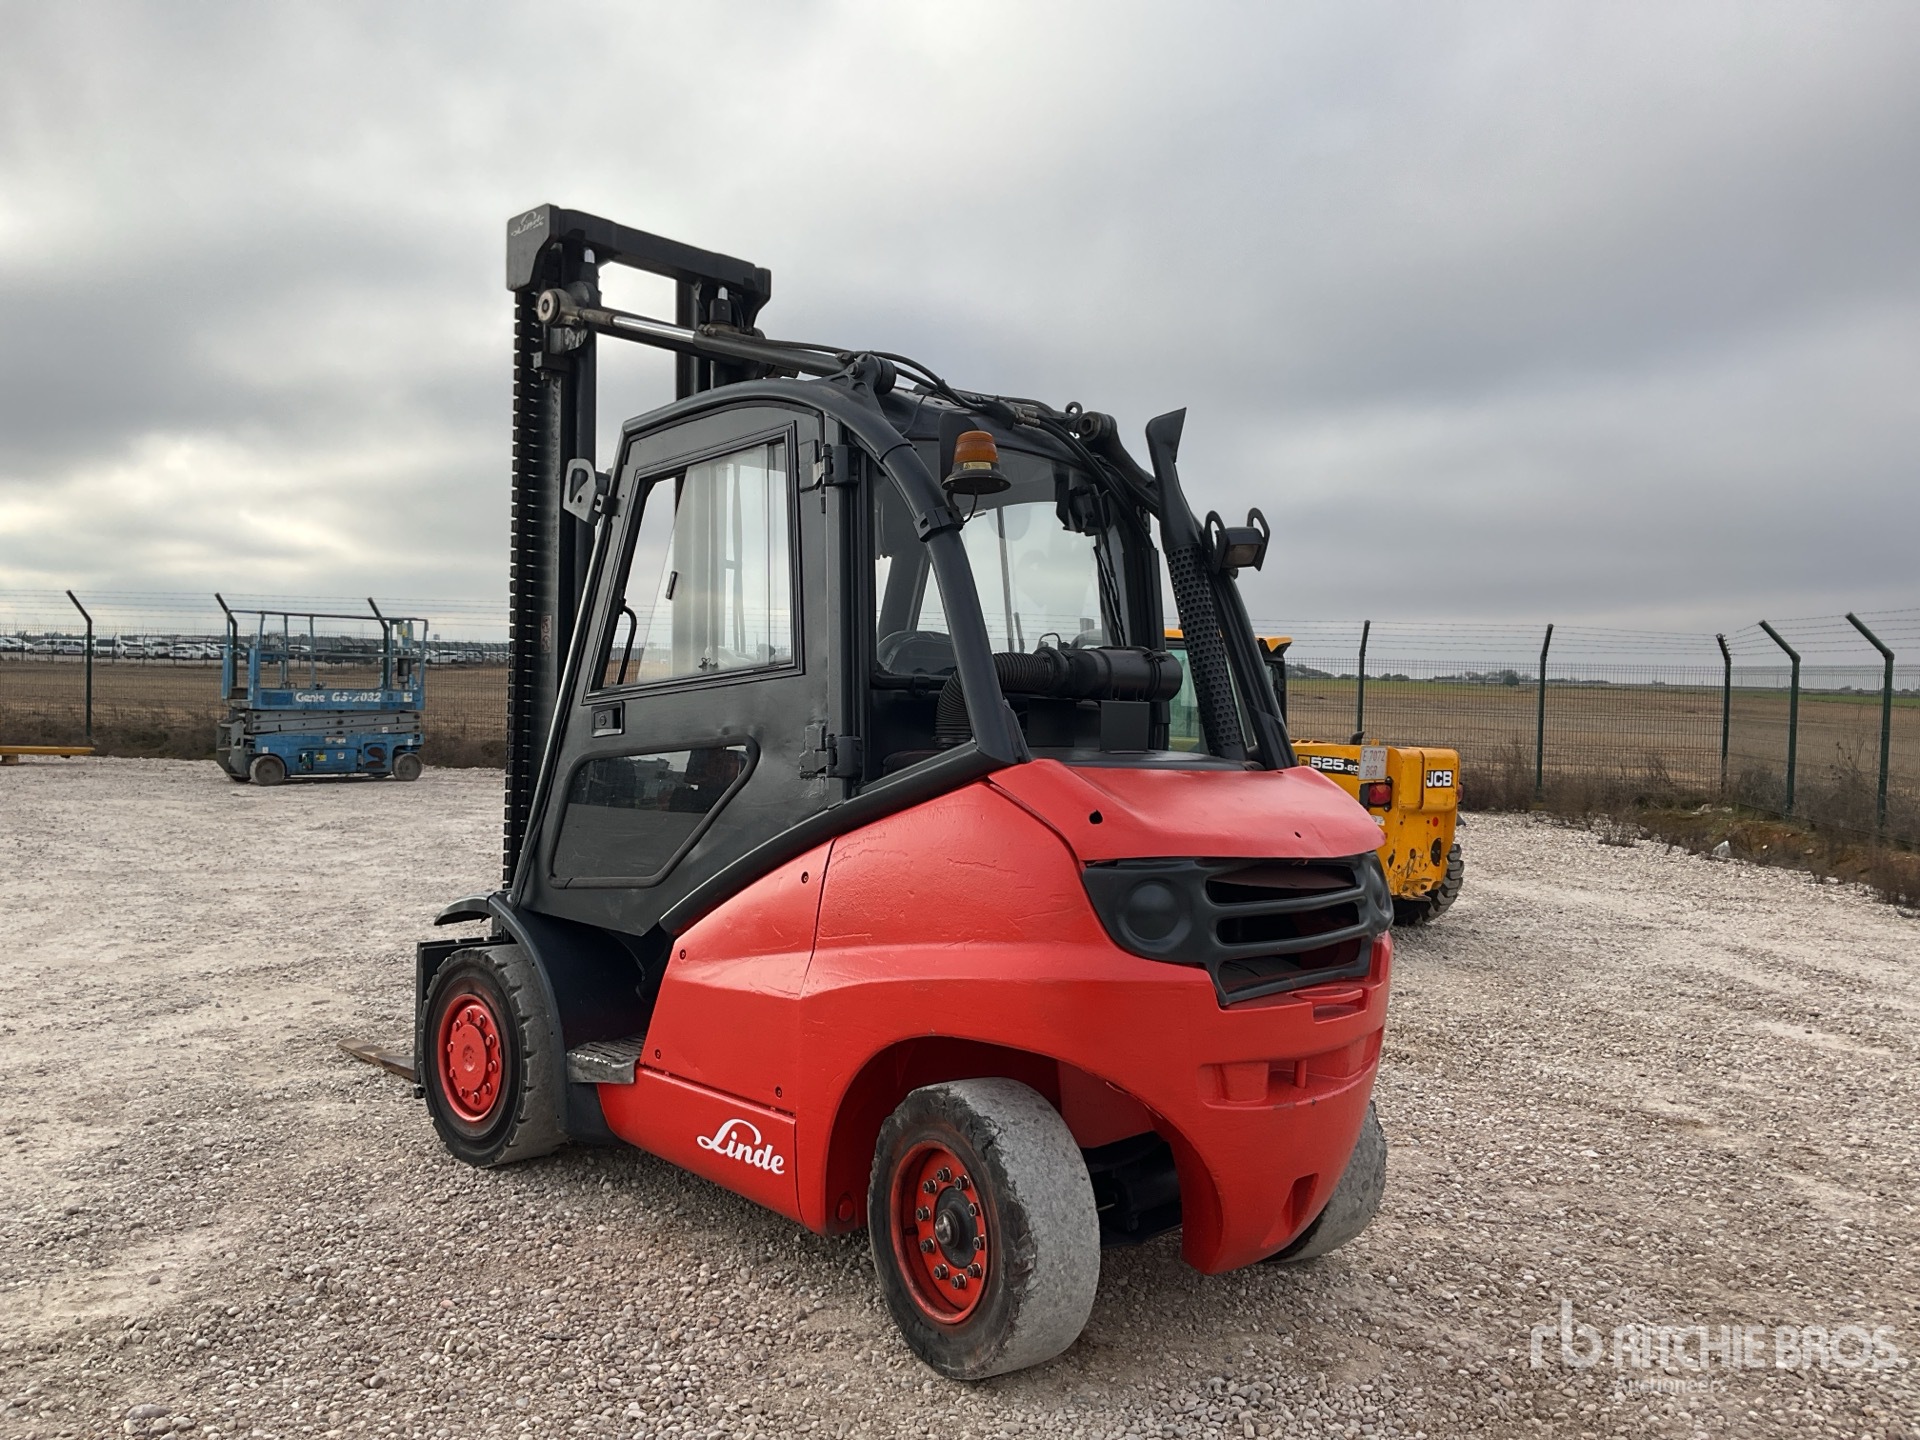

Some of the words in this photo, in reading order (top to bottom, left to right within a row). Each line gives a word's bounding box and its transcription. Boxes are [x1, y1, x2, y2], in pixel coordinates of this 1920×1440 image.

[295, 692, 325, 702] Genie
[1426, 771, 1453, 787] JCB
[696, 1118, 785, 1175] Linde
